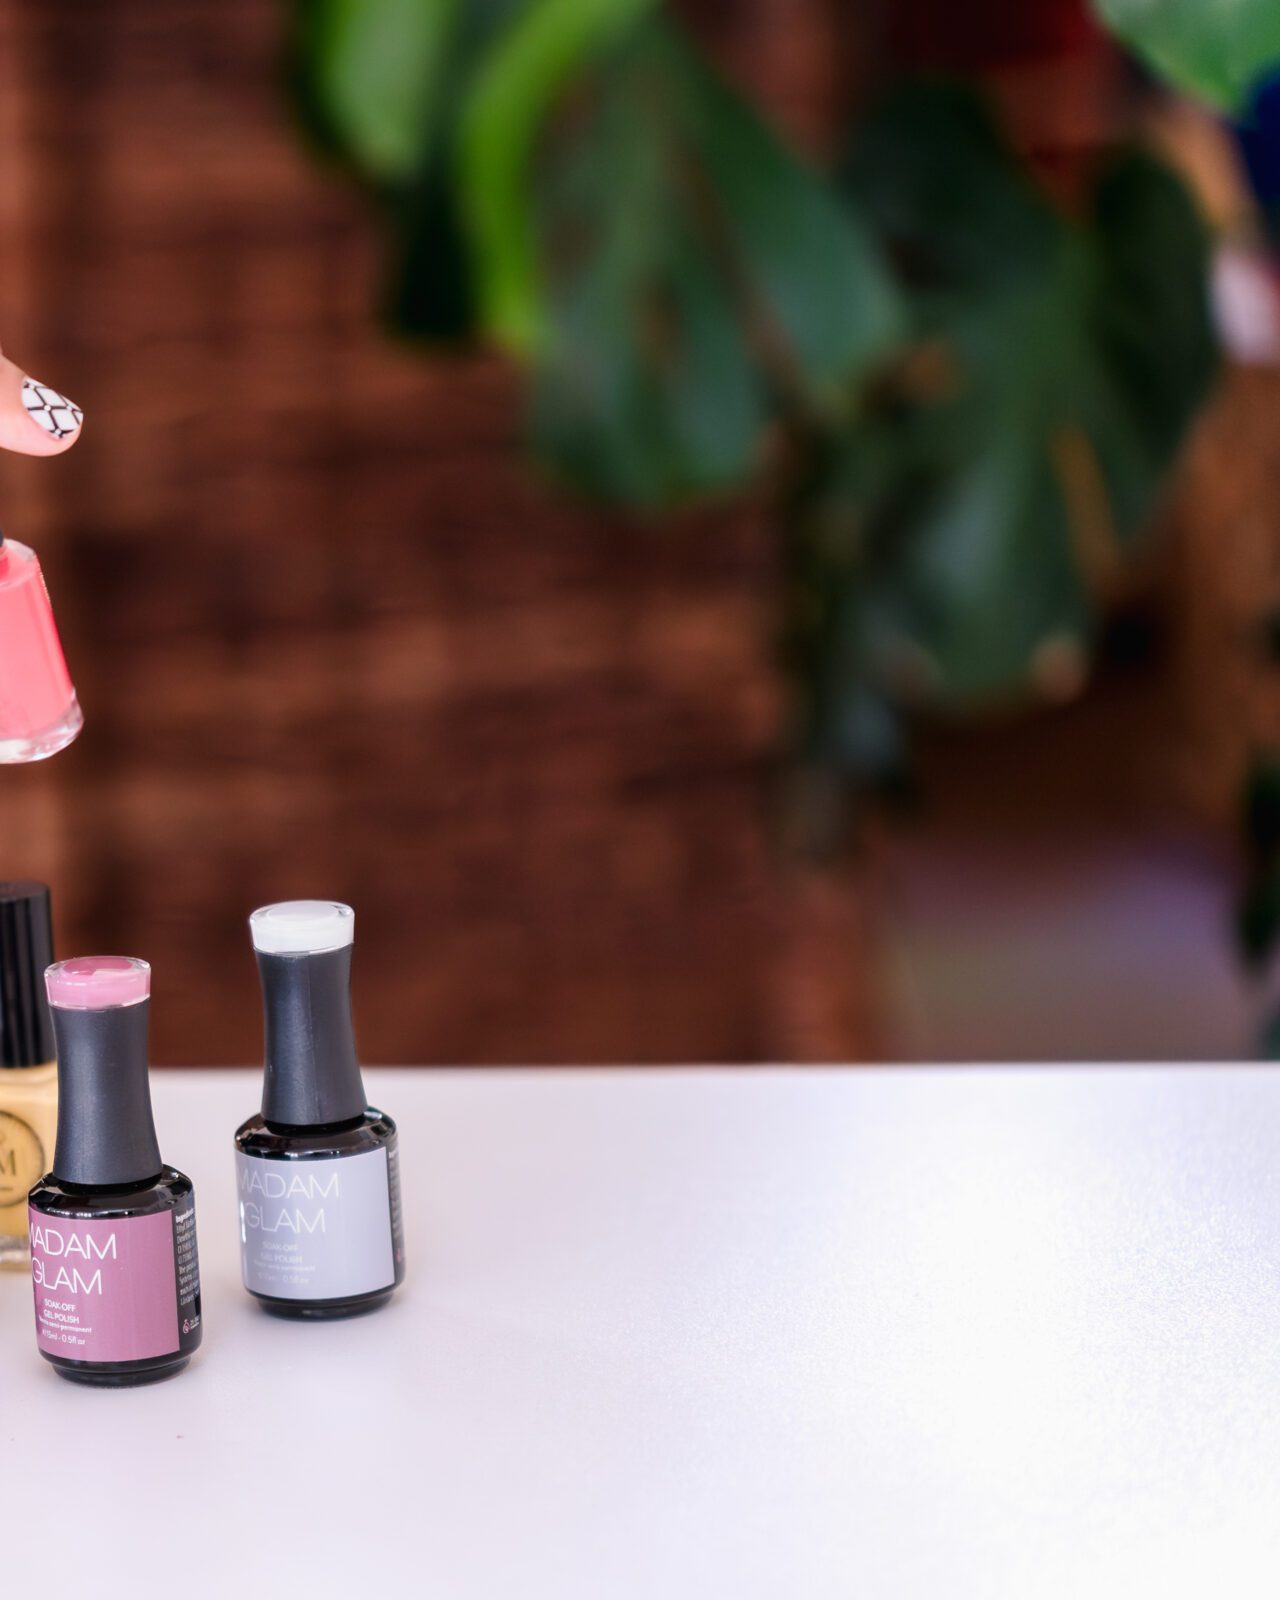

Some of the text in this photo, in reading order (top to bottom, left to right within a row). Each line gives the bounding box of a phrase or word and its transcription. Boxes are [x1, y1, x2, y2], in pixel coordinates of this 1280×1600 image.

[245, 1202, 326, 1233] GLAM
[32, 1257, 103, 1295] GLAM
[54, 1312, 80, 1325] POLISH
